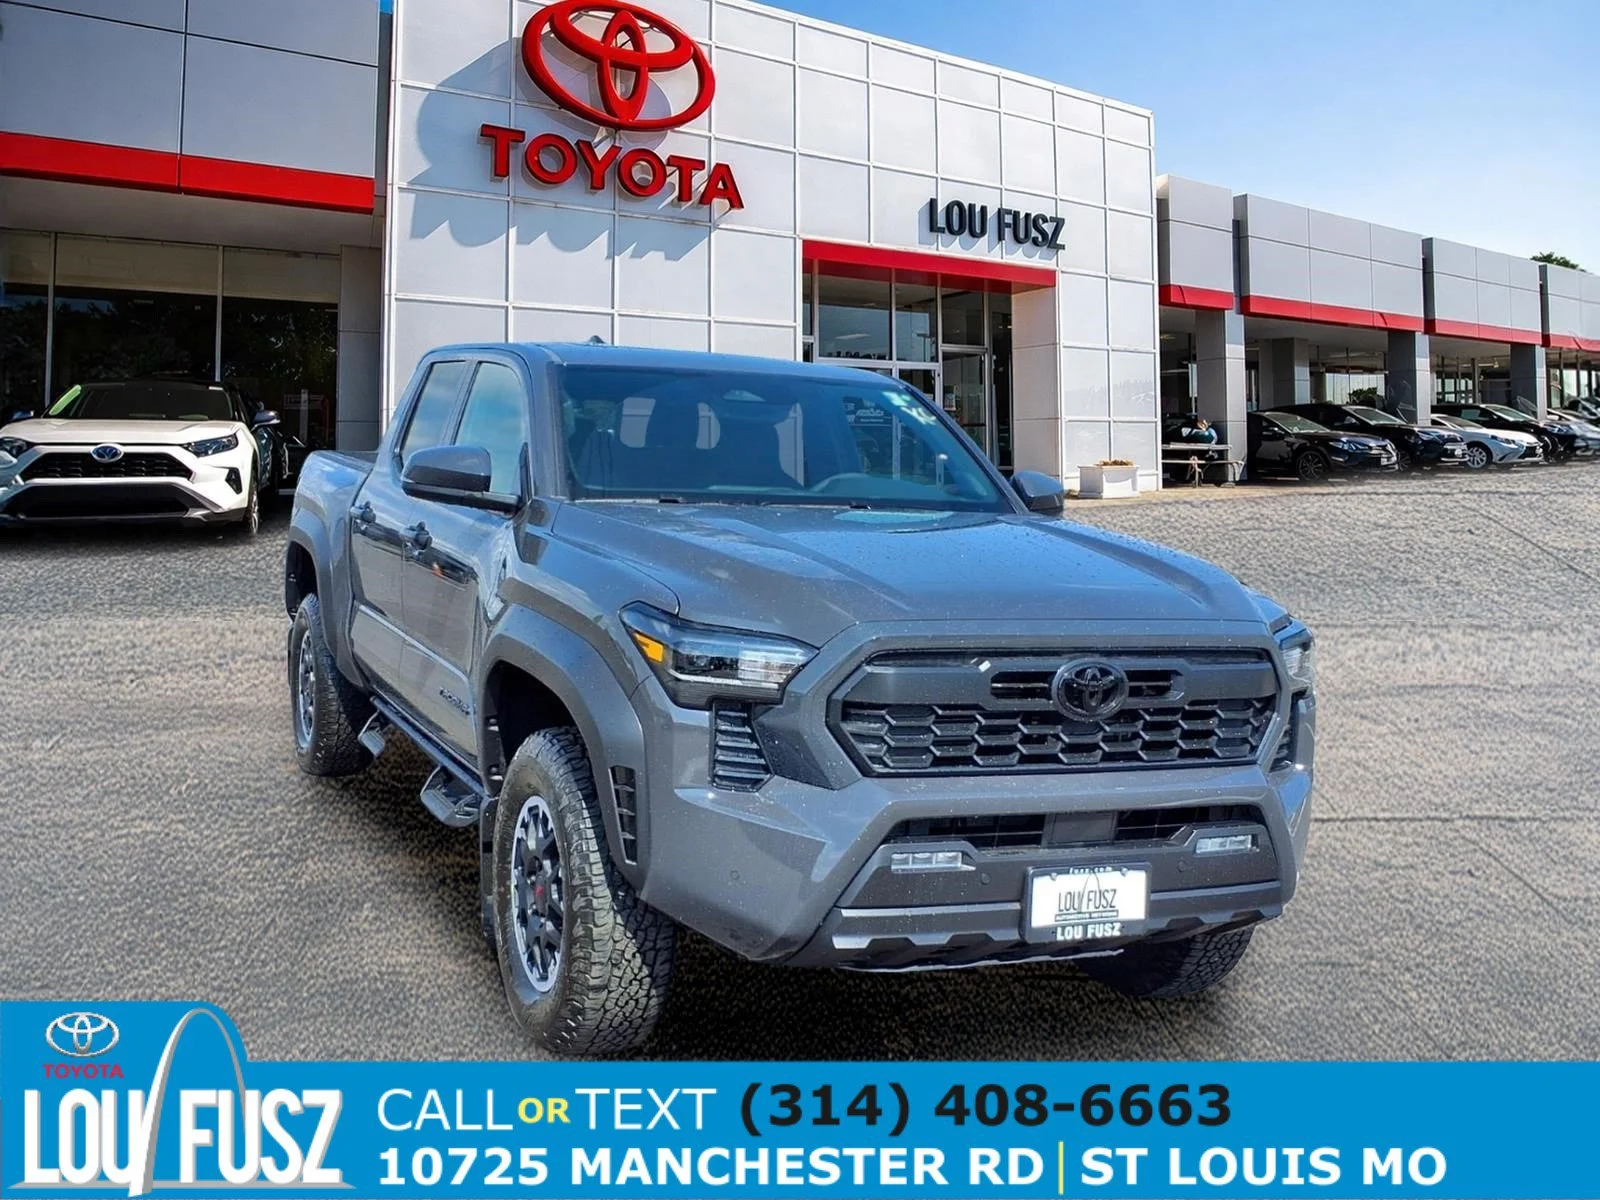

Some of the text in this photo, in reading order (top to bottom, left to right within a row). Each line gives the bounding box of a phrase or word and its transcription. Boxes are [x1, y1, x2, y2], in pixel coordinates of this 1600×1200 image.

[481, 124, 743, 210] TOYOTA
[929, 198, 1065, 250] LOU FUSZ
[1058, 888, 1118, 912] LOU FUSZ
[1056, 922, 1121, 941] LOU FUSZ
